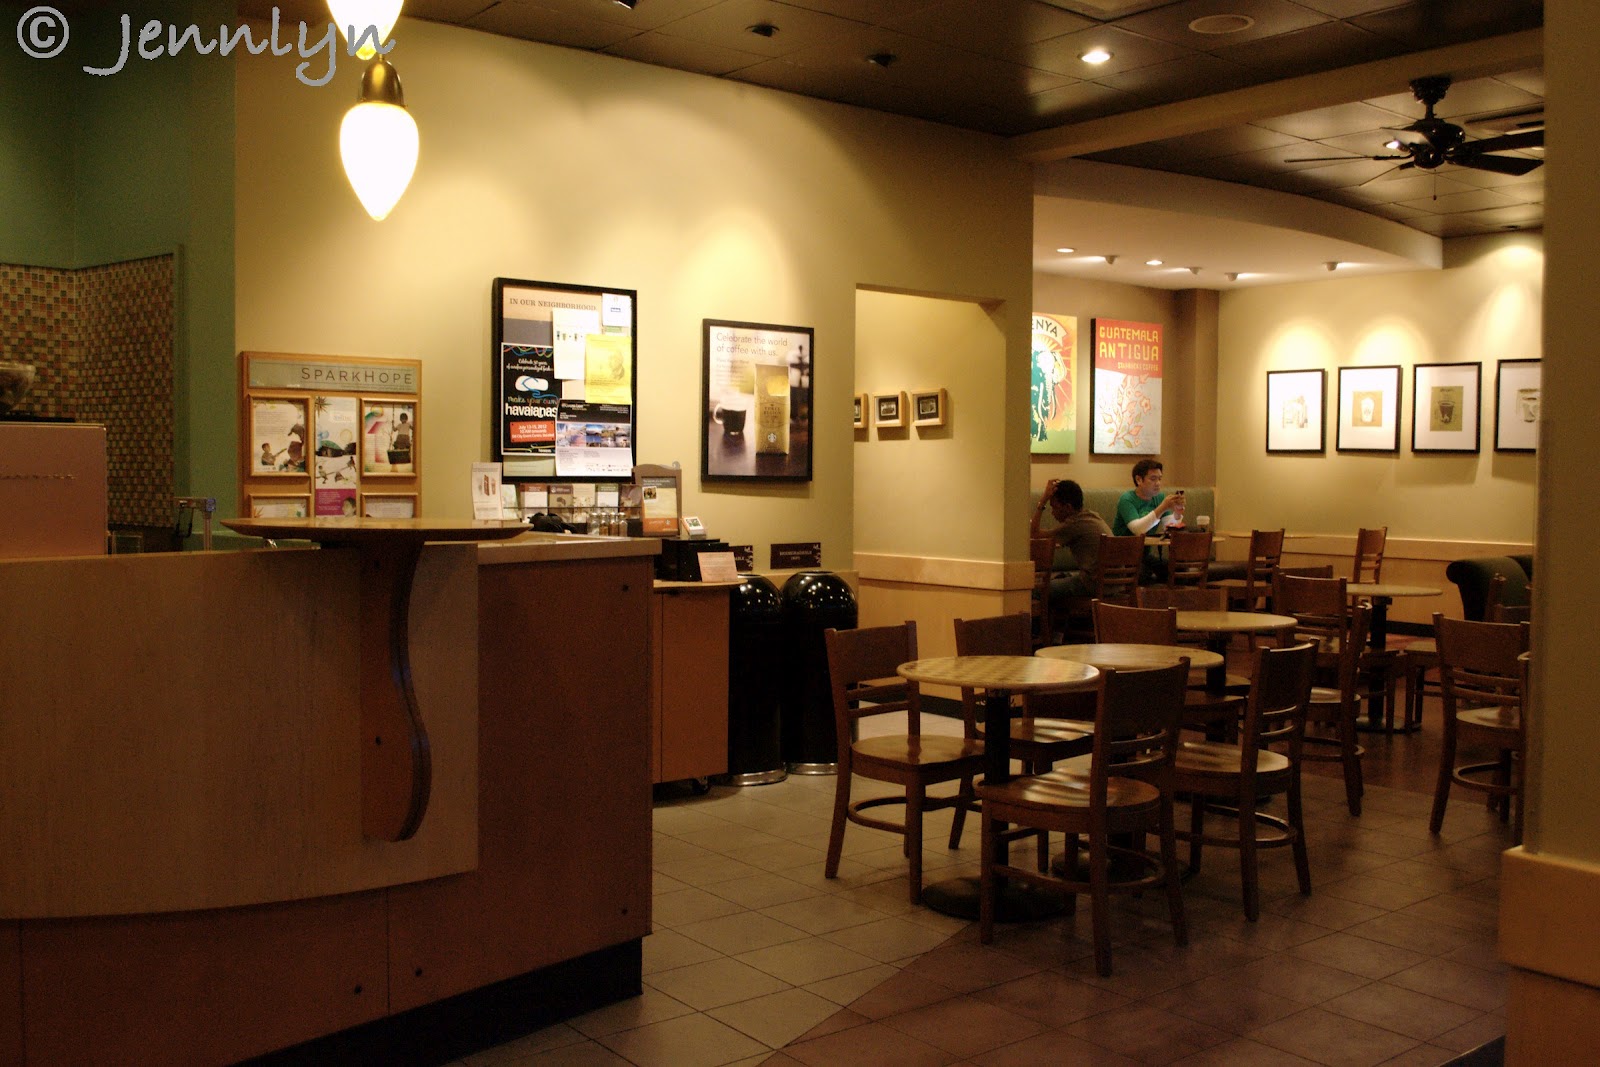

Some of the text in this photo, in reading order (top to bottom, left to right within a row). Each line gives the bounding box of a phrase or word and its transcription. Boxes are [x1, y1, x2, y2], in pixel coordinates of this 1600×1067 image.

[509, 297, 518, 305] IN
[519, 298, 536, 307] OUR
[716, 332, 788, 347] Celebrate the world
[1099, 326, 1159, 343] GUATEMALA
[716, 343, 725, 352] of
[726, 345, 749, 354] coffee
[751, 347, 766, 356] with
[1099, 341, 1159, 362] ANTIGUA
[301, 367, 413, 385] SPARKHOPE
[505, 403, 557, 418] havaianas
